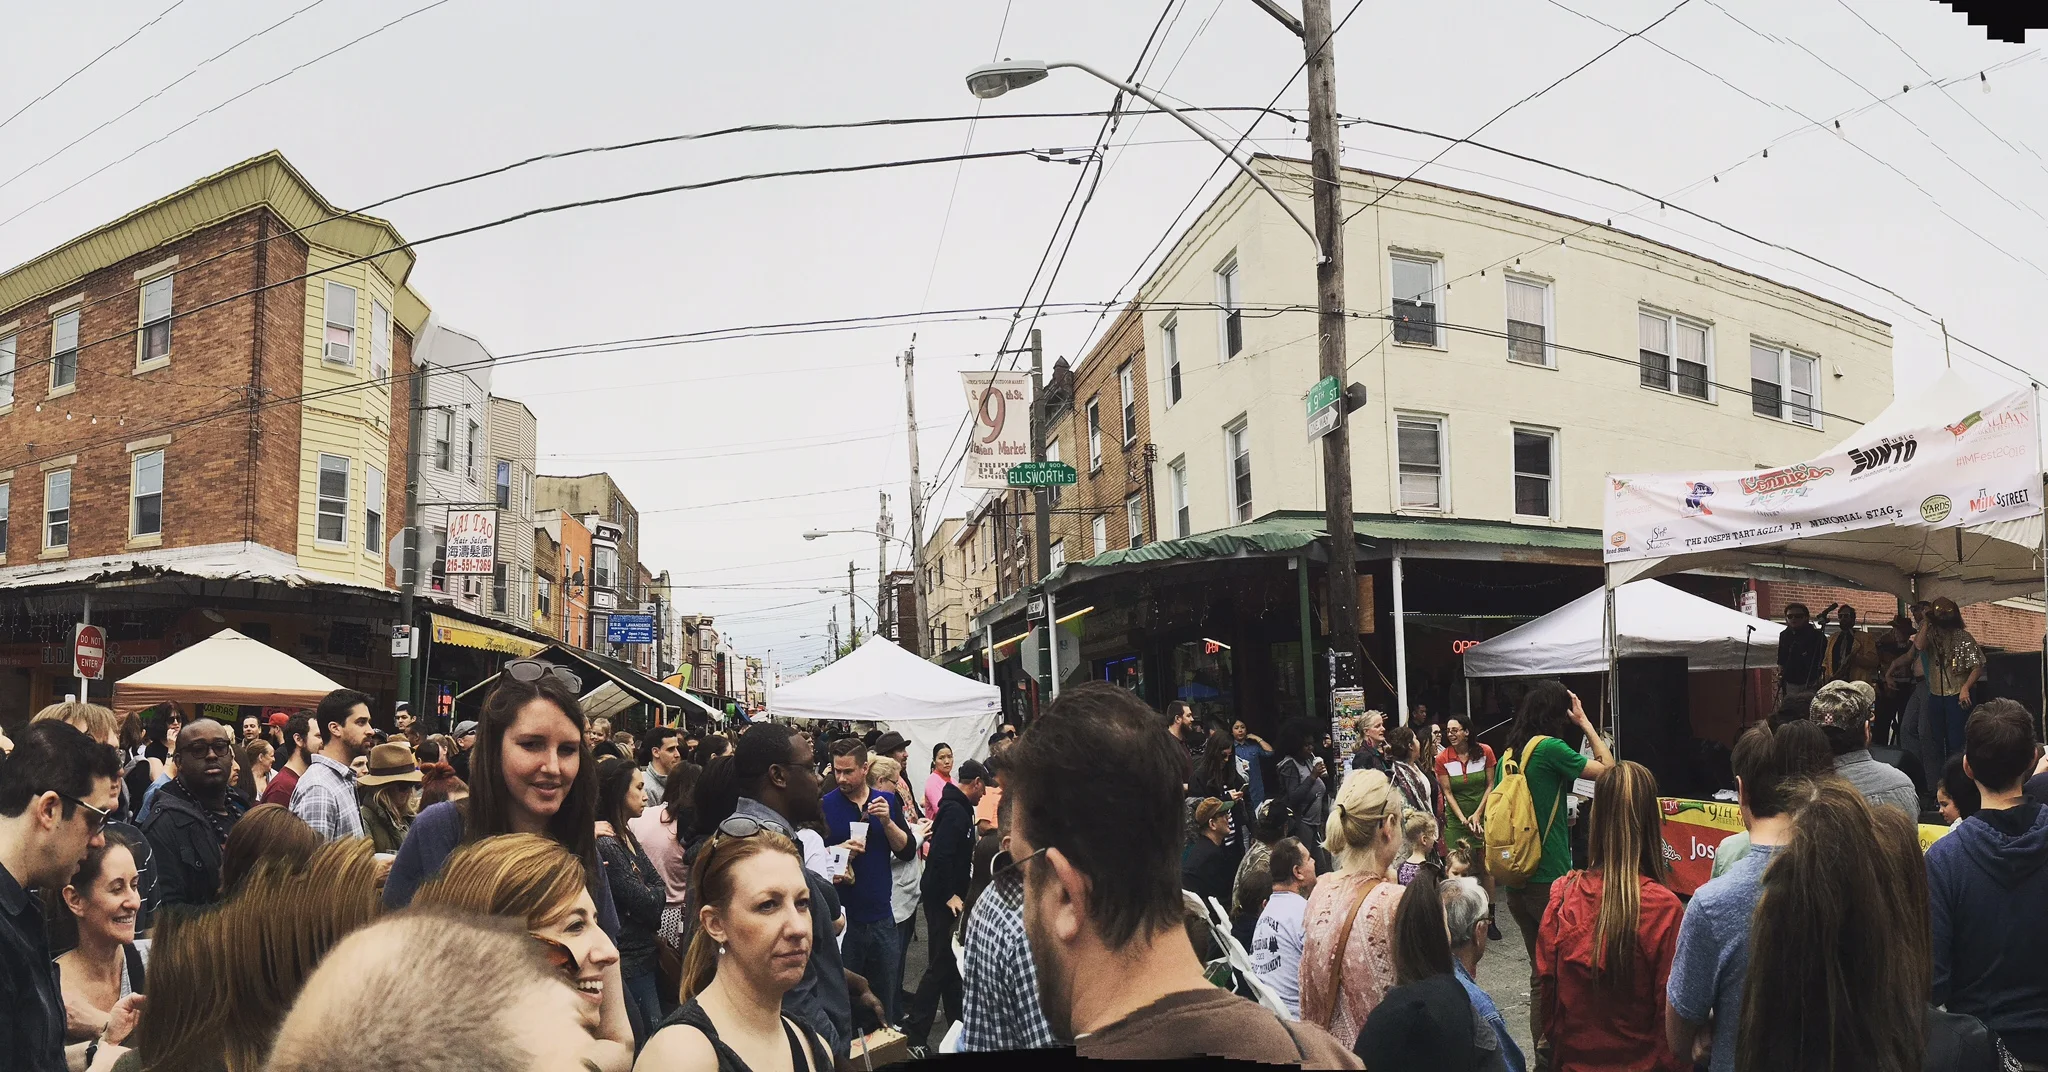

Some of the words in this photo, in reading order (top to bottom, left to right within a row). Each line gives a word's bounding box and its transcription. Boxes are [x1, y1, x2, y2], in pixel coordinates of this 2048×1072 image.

[1313, 391, 1325, 410] 9TH
[1329, 387, 1338, 400] ST
[1881, 434, 1914, 446] music
[998, 441, 1026, 455] Market
[1009, 470, 1064, 483] ELLSWORTH
[1067, 474, 1075, 482] ST
[1738, 463, 1834, 496] Connie's
[1759, 492, 1775, 501] RIC
[1922, 501, 1950, 515] YARDS
[448, 514, 469, 542] HAI
[473, 514, 493, 538] TAO
[1685, 537, 1701, 546] THE
[1704, 533, 1731, 544] JOSEPH
[1732, 525, 1783, 540] TARTAGLIA
[1790, 522, 1802, 530] JR
[1809, 512, 1862, 528] MEMORIAL
[1866, 506, 1903, 520] STAGE
[453, 536, 468, 544] Hair
[470, 536, 487, 544] Salon
[447, 559, 491, 571] 215-551-7369
[80, 635, 89, 644] DO
[90, 637, 102, 646] NOT
[1205, 642, 1219, 654] OPEN
[81, 658, 99, 669] ENTER
[1663, 800, 1678, 811] IM
[1716, 817, 1735, 826] STREET
[1690, 836, 1715, 860] Jos
